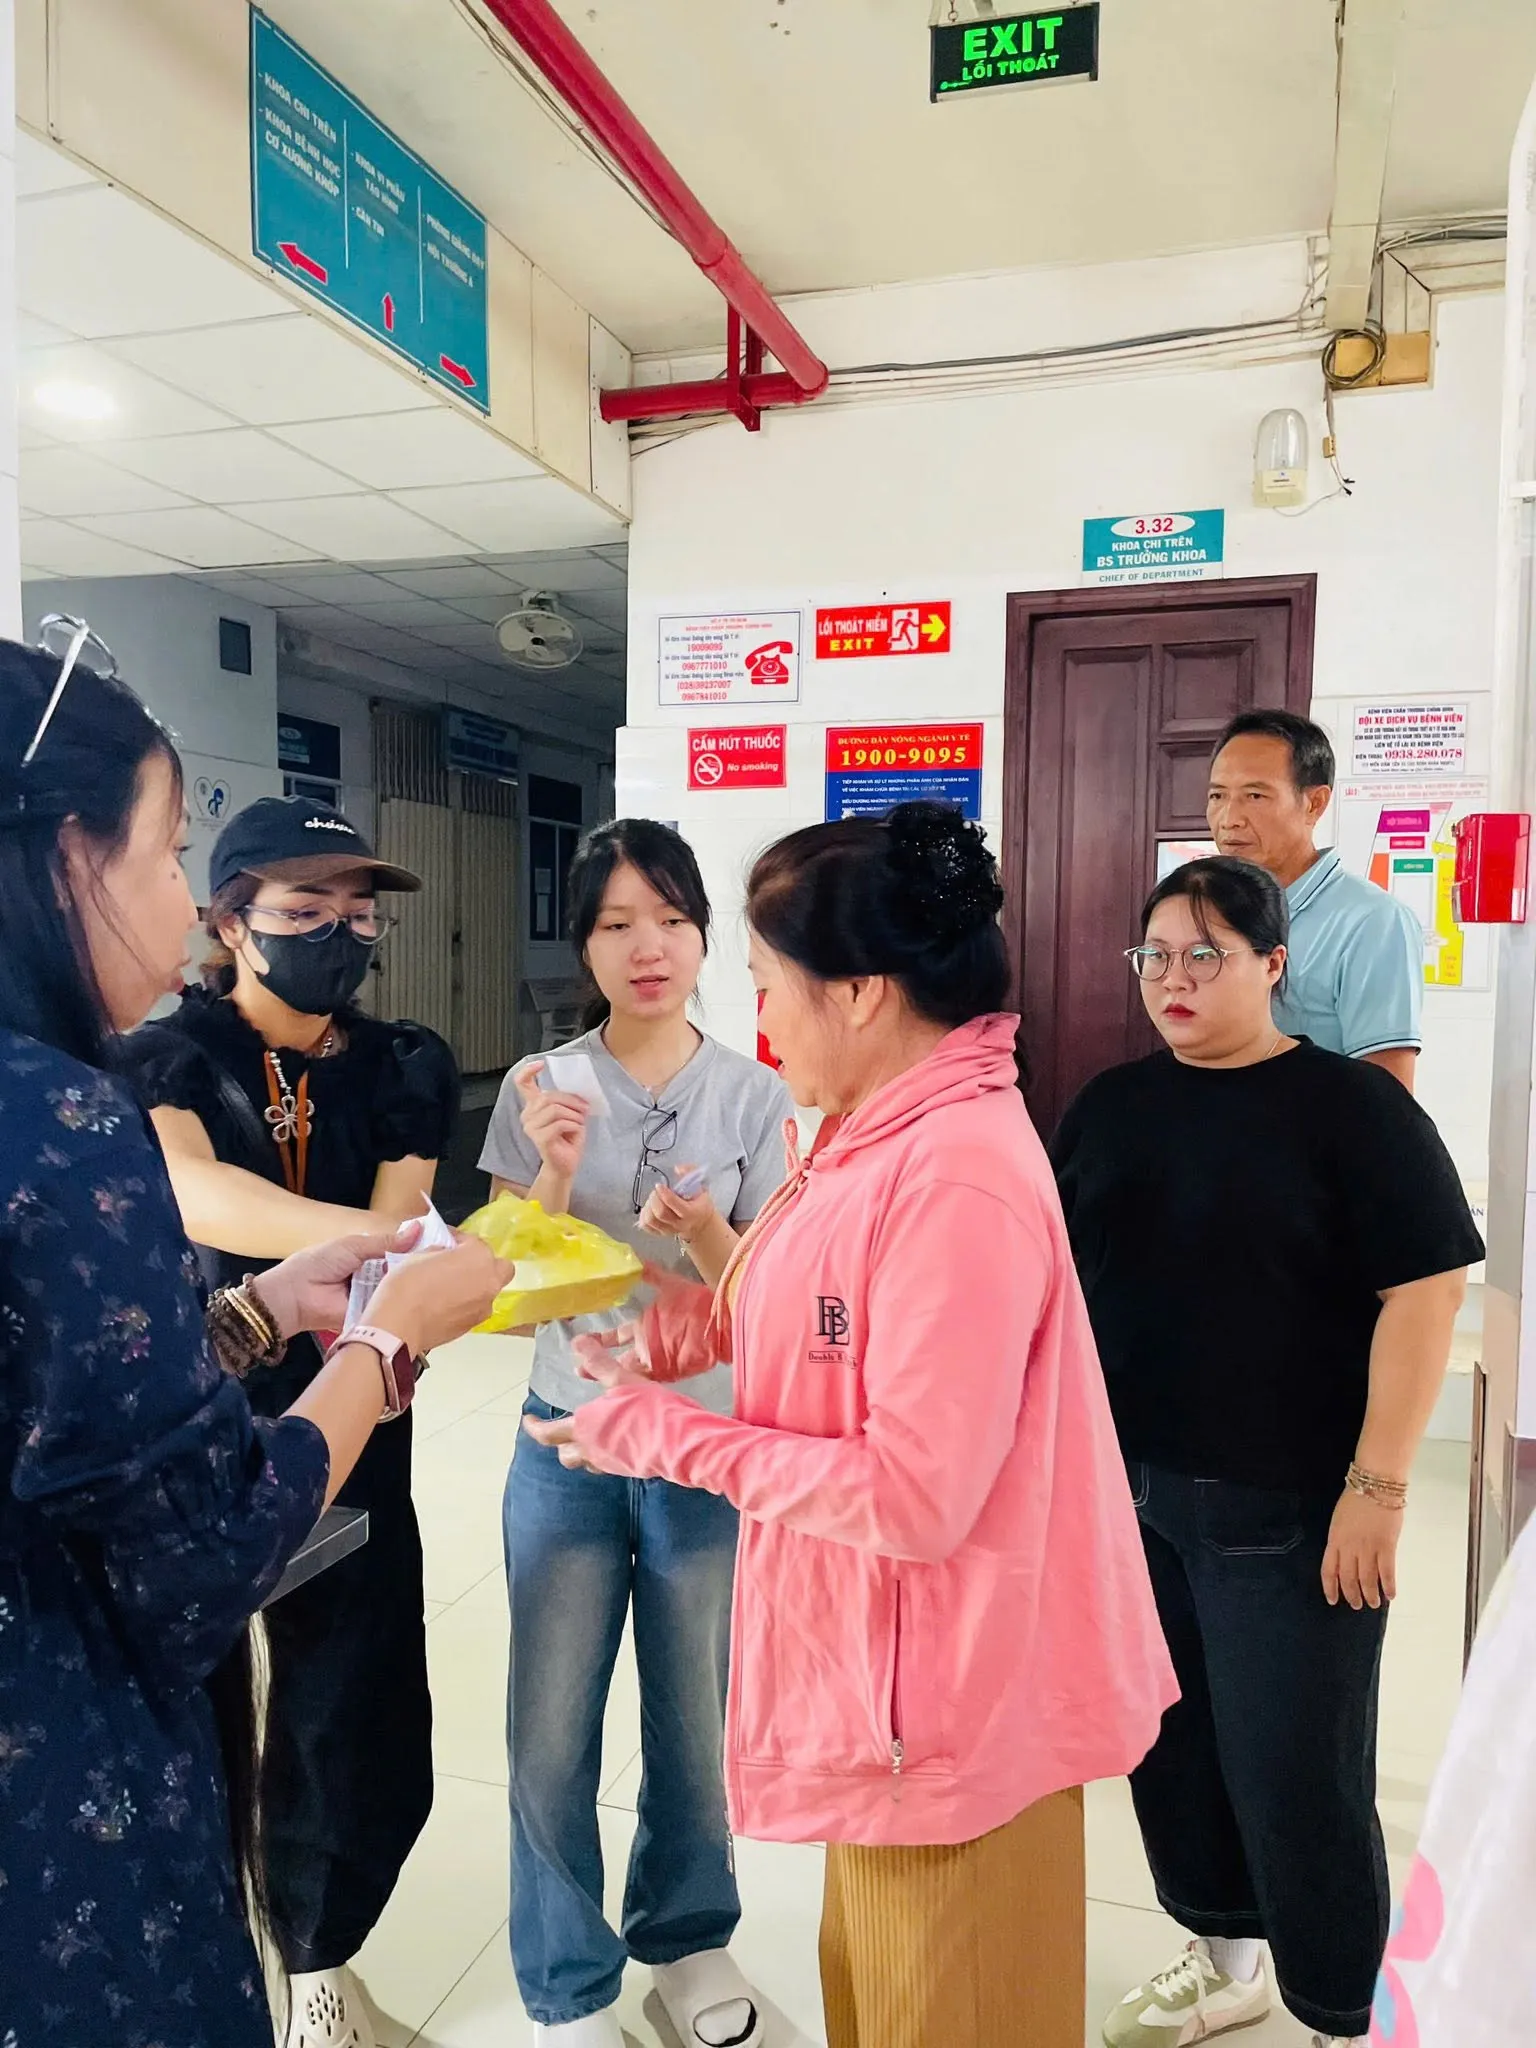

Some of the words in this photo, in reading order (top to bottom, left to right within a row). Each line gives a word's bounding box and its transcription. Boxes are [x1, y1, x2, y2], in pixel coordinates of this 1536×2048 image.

[964, 17, 1063, 60] EXIT
[962, 60, 992, 81] LỐI
[997, 52, 1060, 76] THOÁT
[265, 72, 292, 106] KHOA
[293, 98, 310, 121] CHI
[312, 112, 337, 144] TRÊN
[265, 107, 292, 140] KHOA
[1135, 517, 1174, 535] 3.32
[1111, 541, 1141, 552] KHOA
[1143, 540, 1161, 550] CHI
[1164, 536, 1193, 548] TRÊN
[1096, 556, 1114, 568] BS
[1117, 549, 1169, 567] TRƯỞNG
[1172, 548, 1207, 562] KHOA
[1099, 574, 1126, 583] CHIEF
[1128, 572, 1139, 581] OF
[1142, 569, 1204, 580] DEPARTMENT
[818, 616, 833, 636] LỐI
[834, 614, 864, 635] THOÁT
[829, 637, 875, 652] EXIT
[1358, 715, 1372, 726] ĐỘI
[1374, 716, 1384, 724] XE
[1386, 715, 1406, 726] DỊCH
[1407, 714, 1418, 724] VỤ
[691, 733, 716, 752] CẤM
[719, 733, 741, 751] HÚT
[743, 730, 781, 749] THUỐC
[840, 746, 967, 767] 1900-9095
[1384, 747, 1463, 760] 0938.280.078
[727, 763, 740, 772] No
[741, 761, 779, 773] smoking
